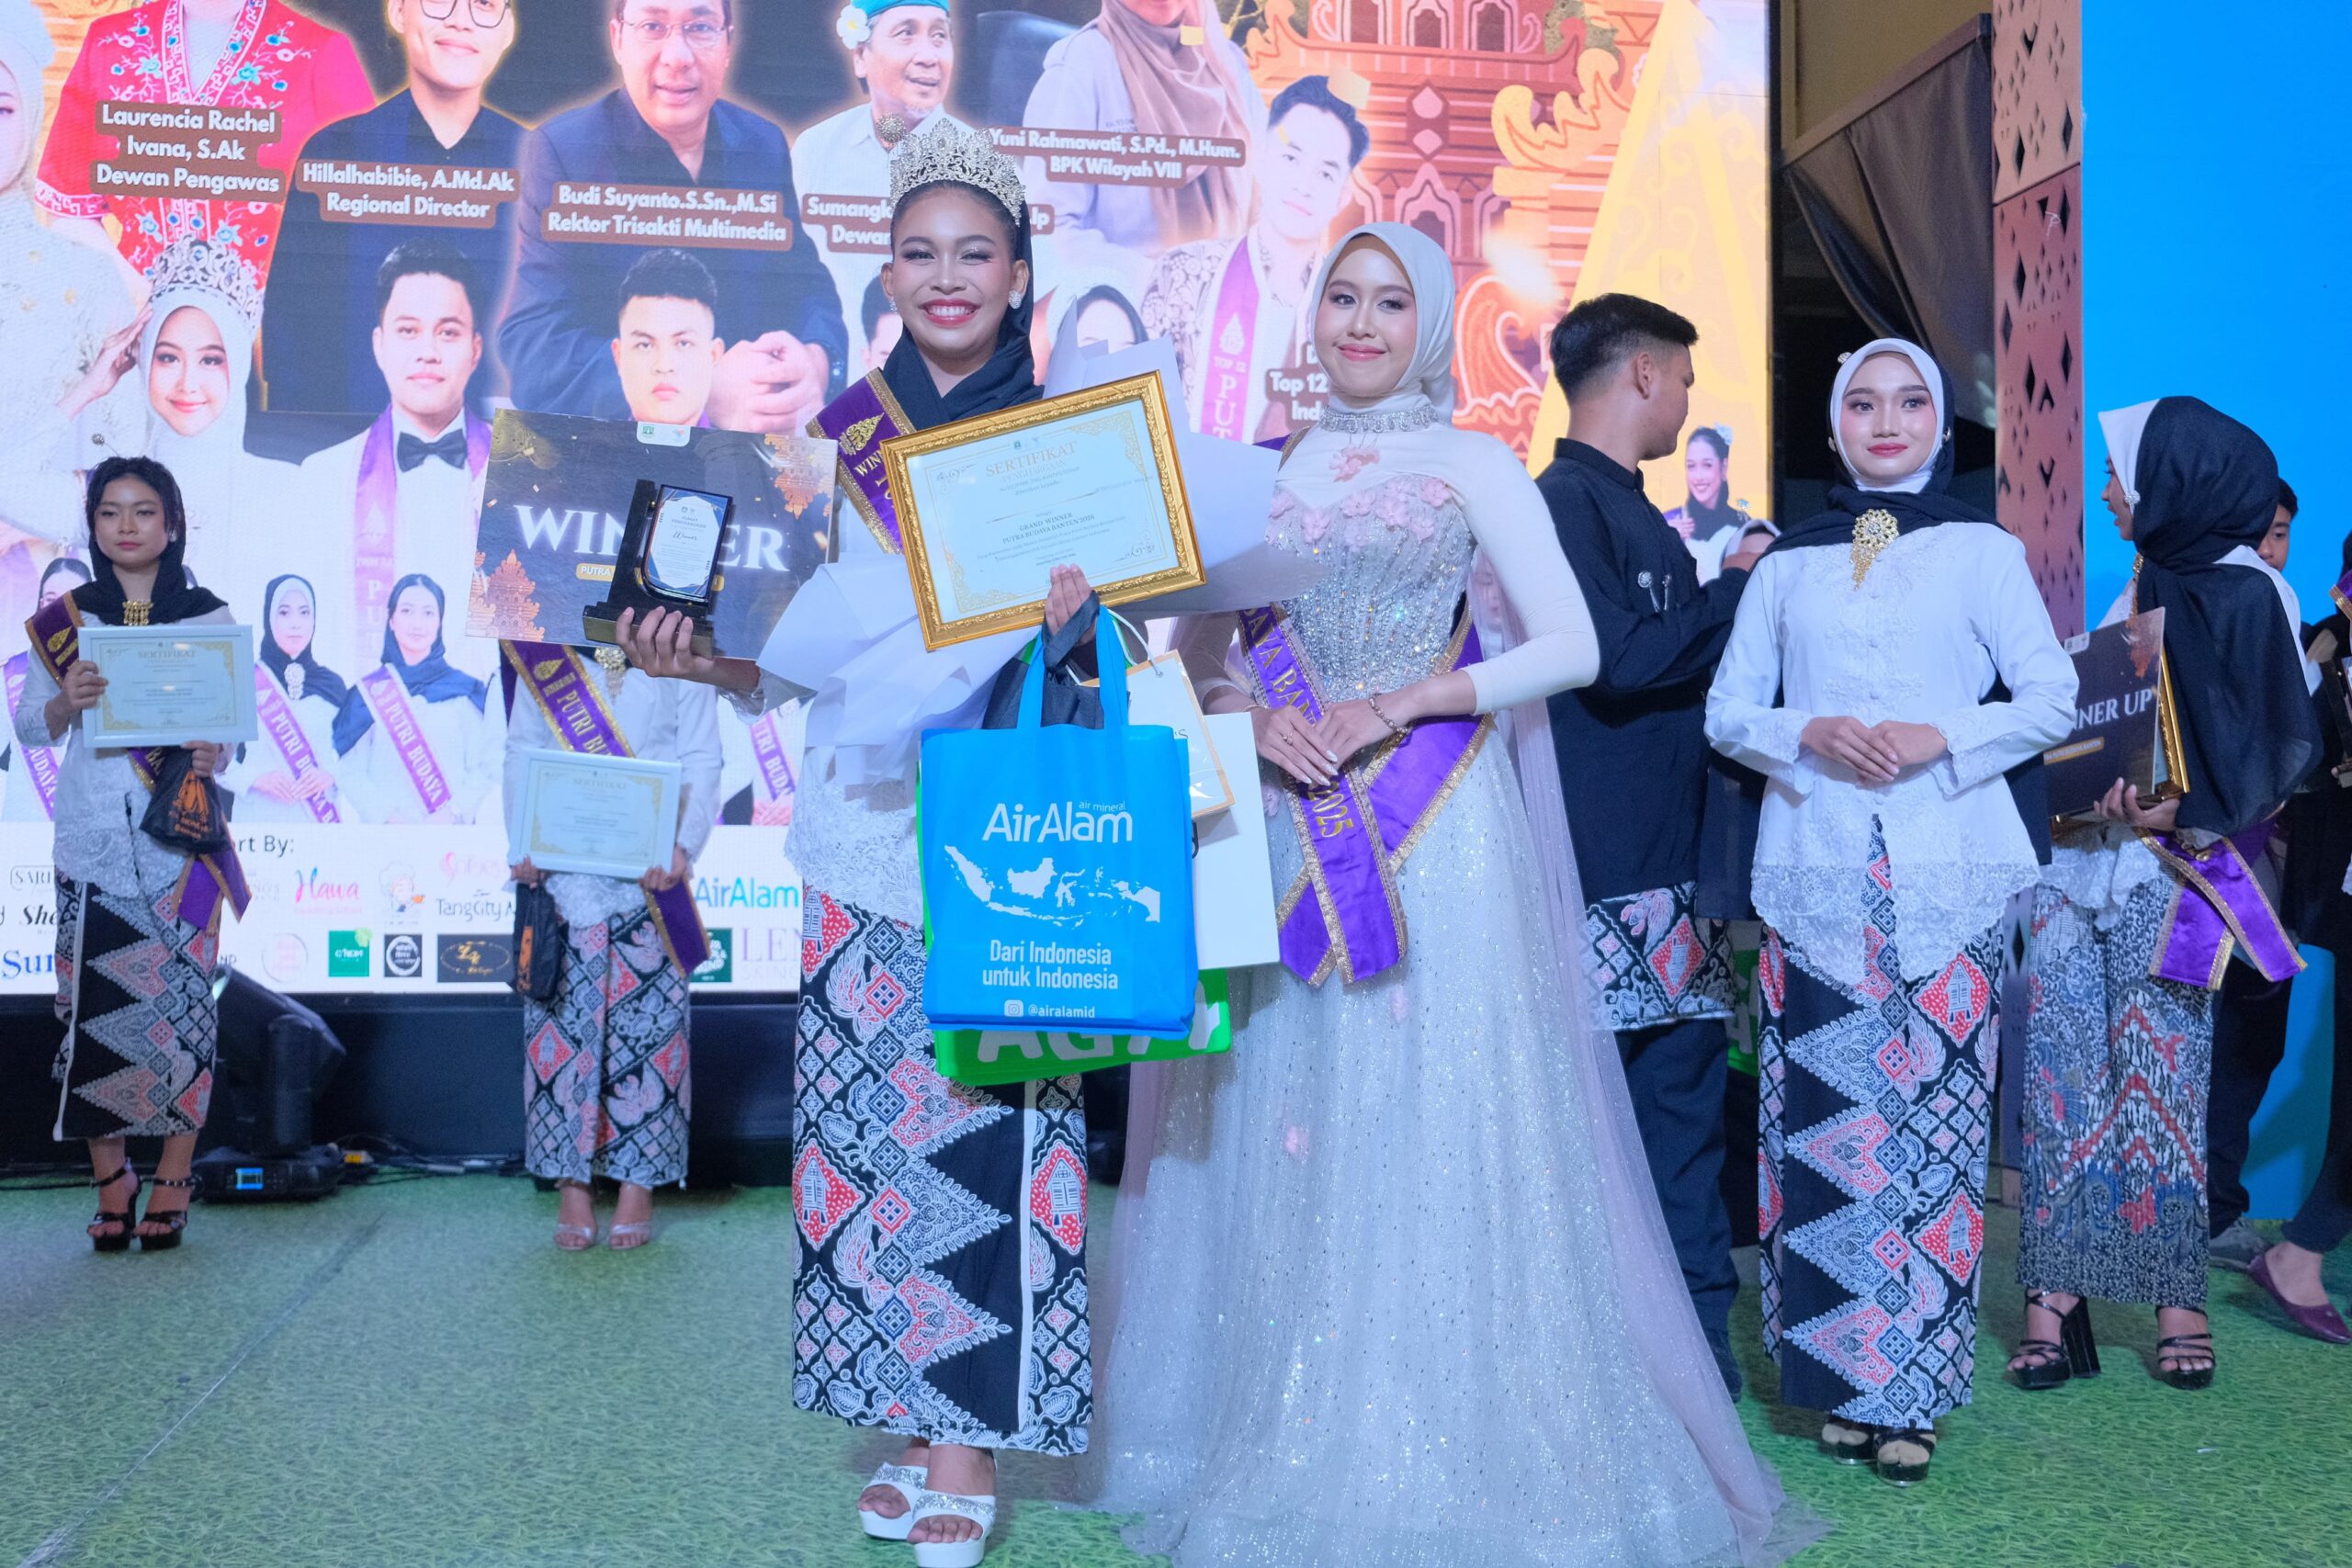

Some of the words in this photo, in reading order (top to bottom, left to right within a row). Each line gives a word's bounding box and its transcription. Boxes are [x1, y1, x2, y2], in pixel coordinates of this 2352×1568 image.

[102, 104, 203, 130] Laurencia
[209, 109, 275, 133] Rachel
[127, 135, 192, 162] Ivana,
[197, 138, 245, 161] S.Ak
[989, 128, 1026, 148] Yuni
[1028, 130, 1126, 155] Rahmawati,
[1130, 137, 1177, 157] S.Pd.,
[1179, 141, 1240, 159] M.Hum.
[96, 164, 169, 186] Dewan
[174, 167, 279, 195] Pengawas
[303, 163, 428, 190] Hillalhabibie,
[431, 169, 514, 192] A.Md.Ak
[1050, 156, 1083, 175] BPK
[1084, 156, 1153, 181] Wilayah
[1155, 162, 1182, 179] VIII
[326, 192, 410, 217] Regional
[414, 196, 491, 218] Director
[559, 185, 601, 206] Budi
[807, 196, 893, 223] Sumangk
[548, 211, 610, 233] Rektor
[612, 215, 681, 237] Trisakti
[684, 218, 786, 242] Multimedia
[1269, 371, 1305, 398] Top
[1306, 372, 1329, 393] 12
[1292, 400, 1321, 421] Ind
[986, 442, 1077, 476] SERTIFIKAT
[580, 565, 612, 577] PUTRA
[557, 690, 596, 737] PUTRI
[2123, 688, 2153, 716] UP
[271, 712, 304, 755] PUTRI
[386, 702, 417, 747] PUTRI
[407, 744, 444, 803] BUDAYA
[28, 747, 58, 798] UDAYA
[1079, 801, 1091, 809] air
[1093, 801, 1126, 812] mineral
[981, 801, 1133, 843] AirAlam
[264, 835, 294, 858] By:
[695, 876, 798, 908] AirAlam
[435, 897, 503, 922] TangCity
[989, 939, 1024, 963] Dari
[1029, 941, 1112, 965] Indonesia
[982, 964, 1031, 987] untuk
[1035, 965, 1118, 989] Indonesia
[1028, 1004, 1096, 1019] @airalamid
